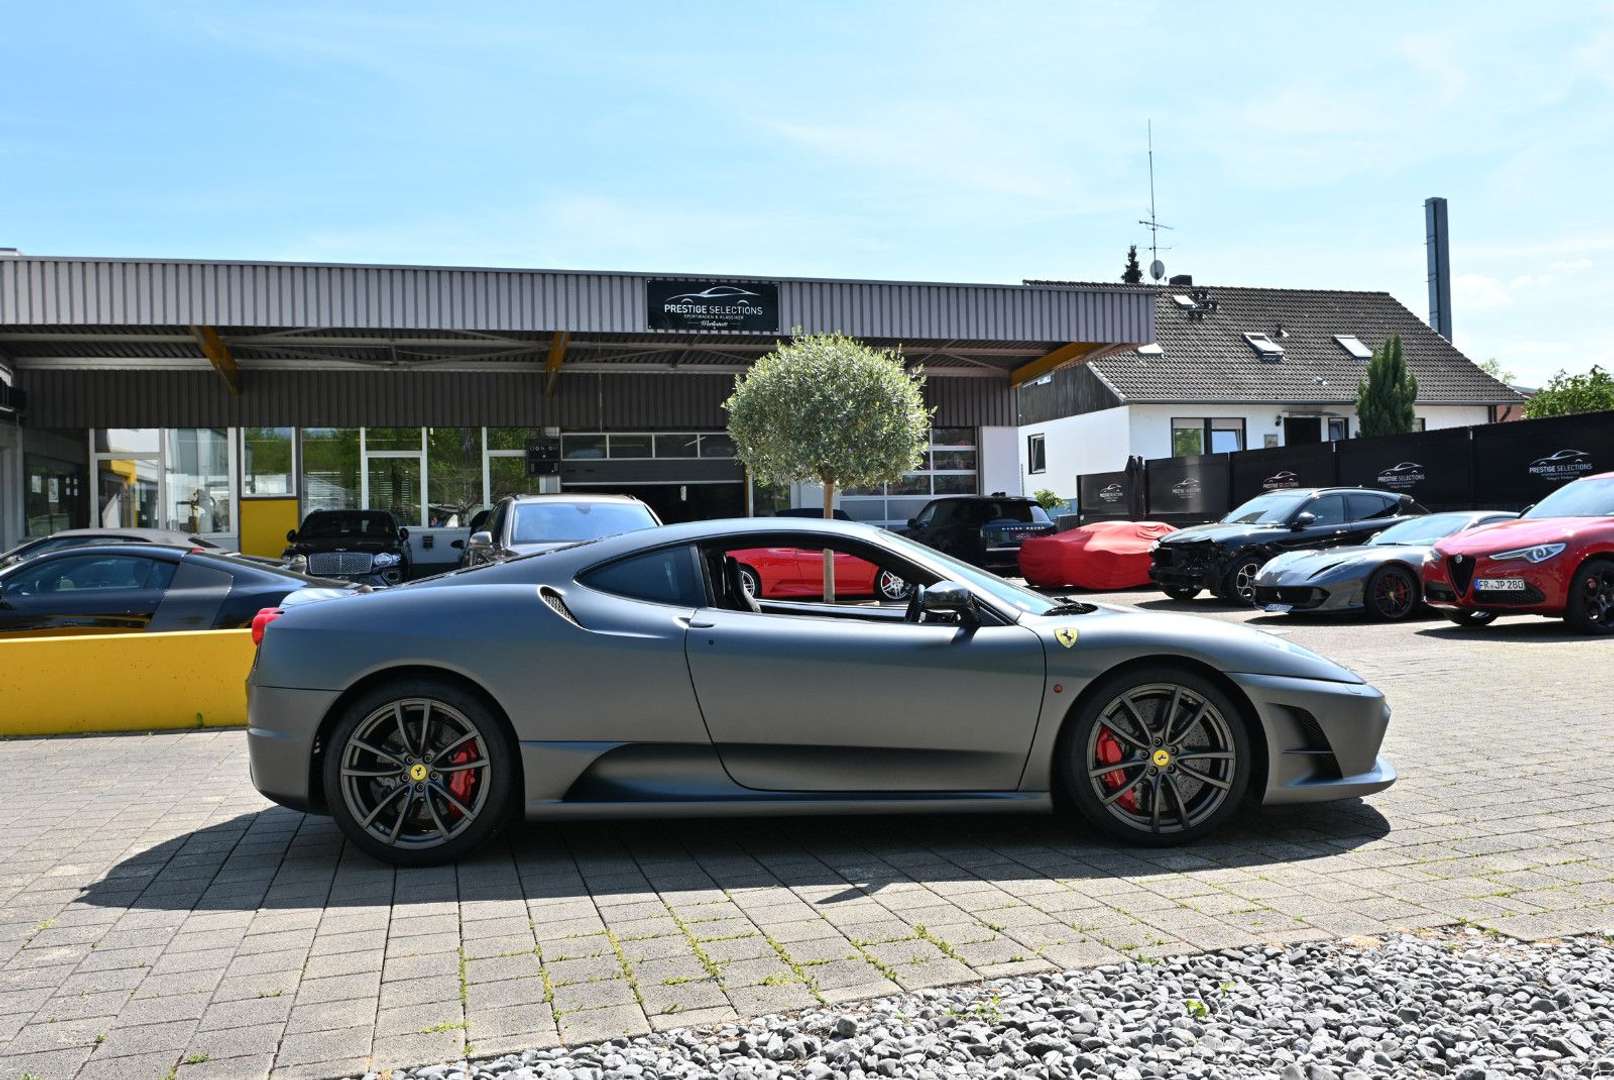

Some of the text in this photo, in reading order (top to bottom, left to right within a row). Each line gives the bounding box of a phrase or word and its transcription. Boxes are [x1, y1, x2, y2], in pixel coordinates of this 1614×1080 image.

[664, 303, 763, 316] PRESTIGE SELECTIONS
[1529, 465, 1556, 474] PRESTIGE
[1556, 463, 1593, 472] SELECTIONS
[1494, 580, 1506, 589] JP
